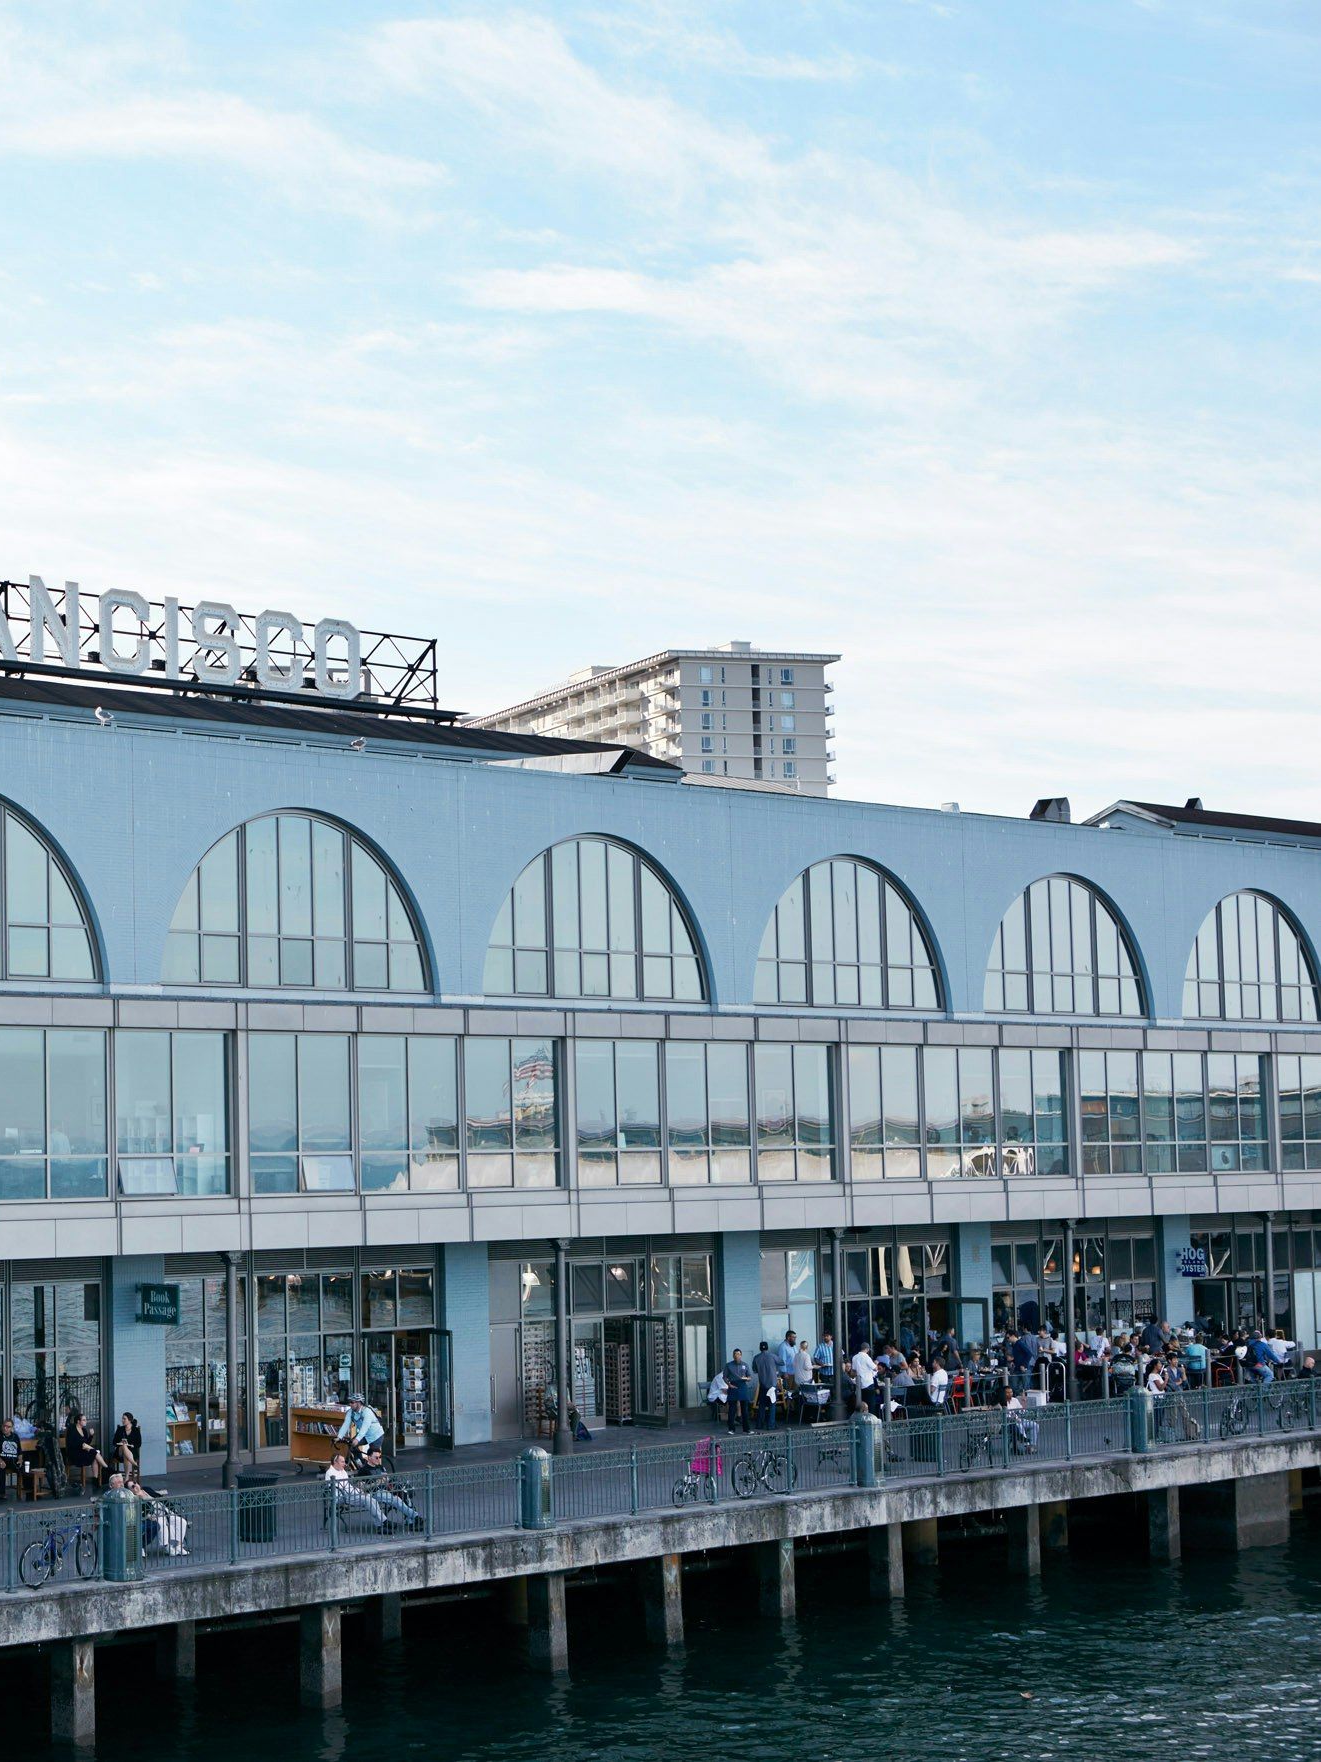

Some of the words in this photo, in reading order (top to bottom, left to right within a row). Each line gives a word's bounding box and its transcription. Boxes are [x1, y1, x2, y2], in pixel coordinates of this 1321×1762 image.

[1181, 1247, 1205, 1260] HOG
[150, 1290, 170, 1303] Book
[144, 1302, 177, 1319] Passage
